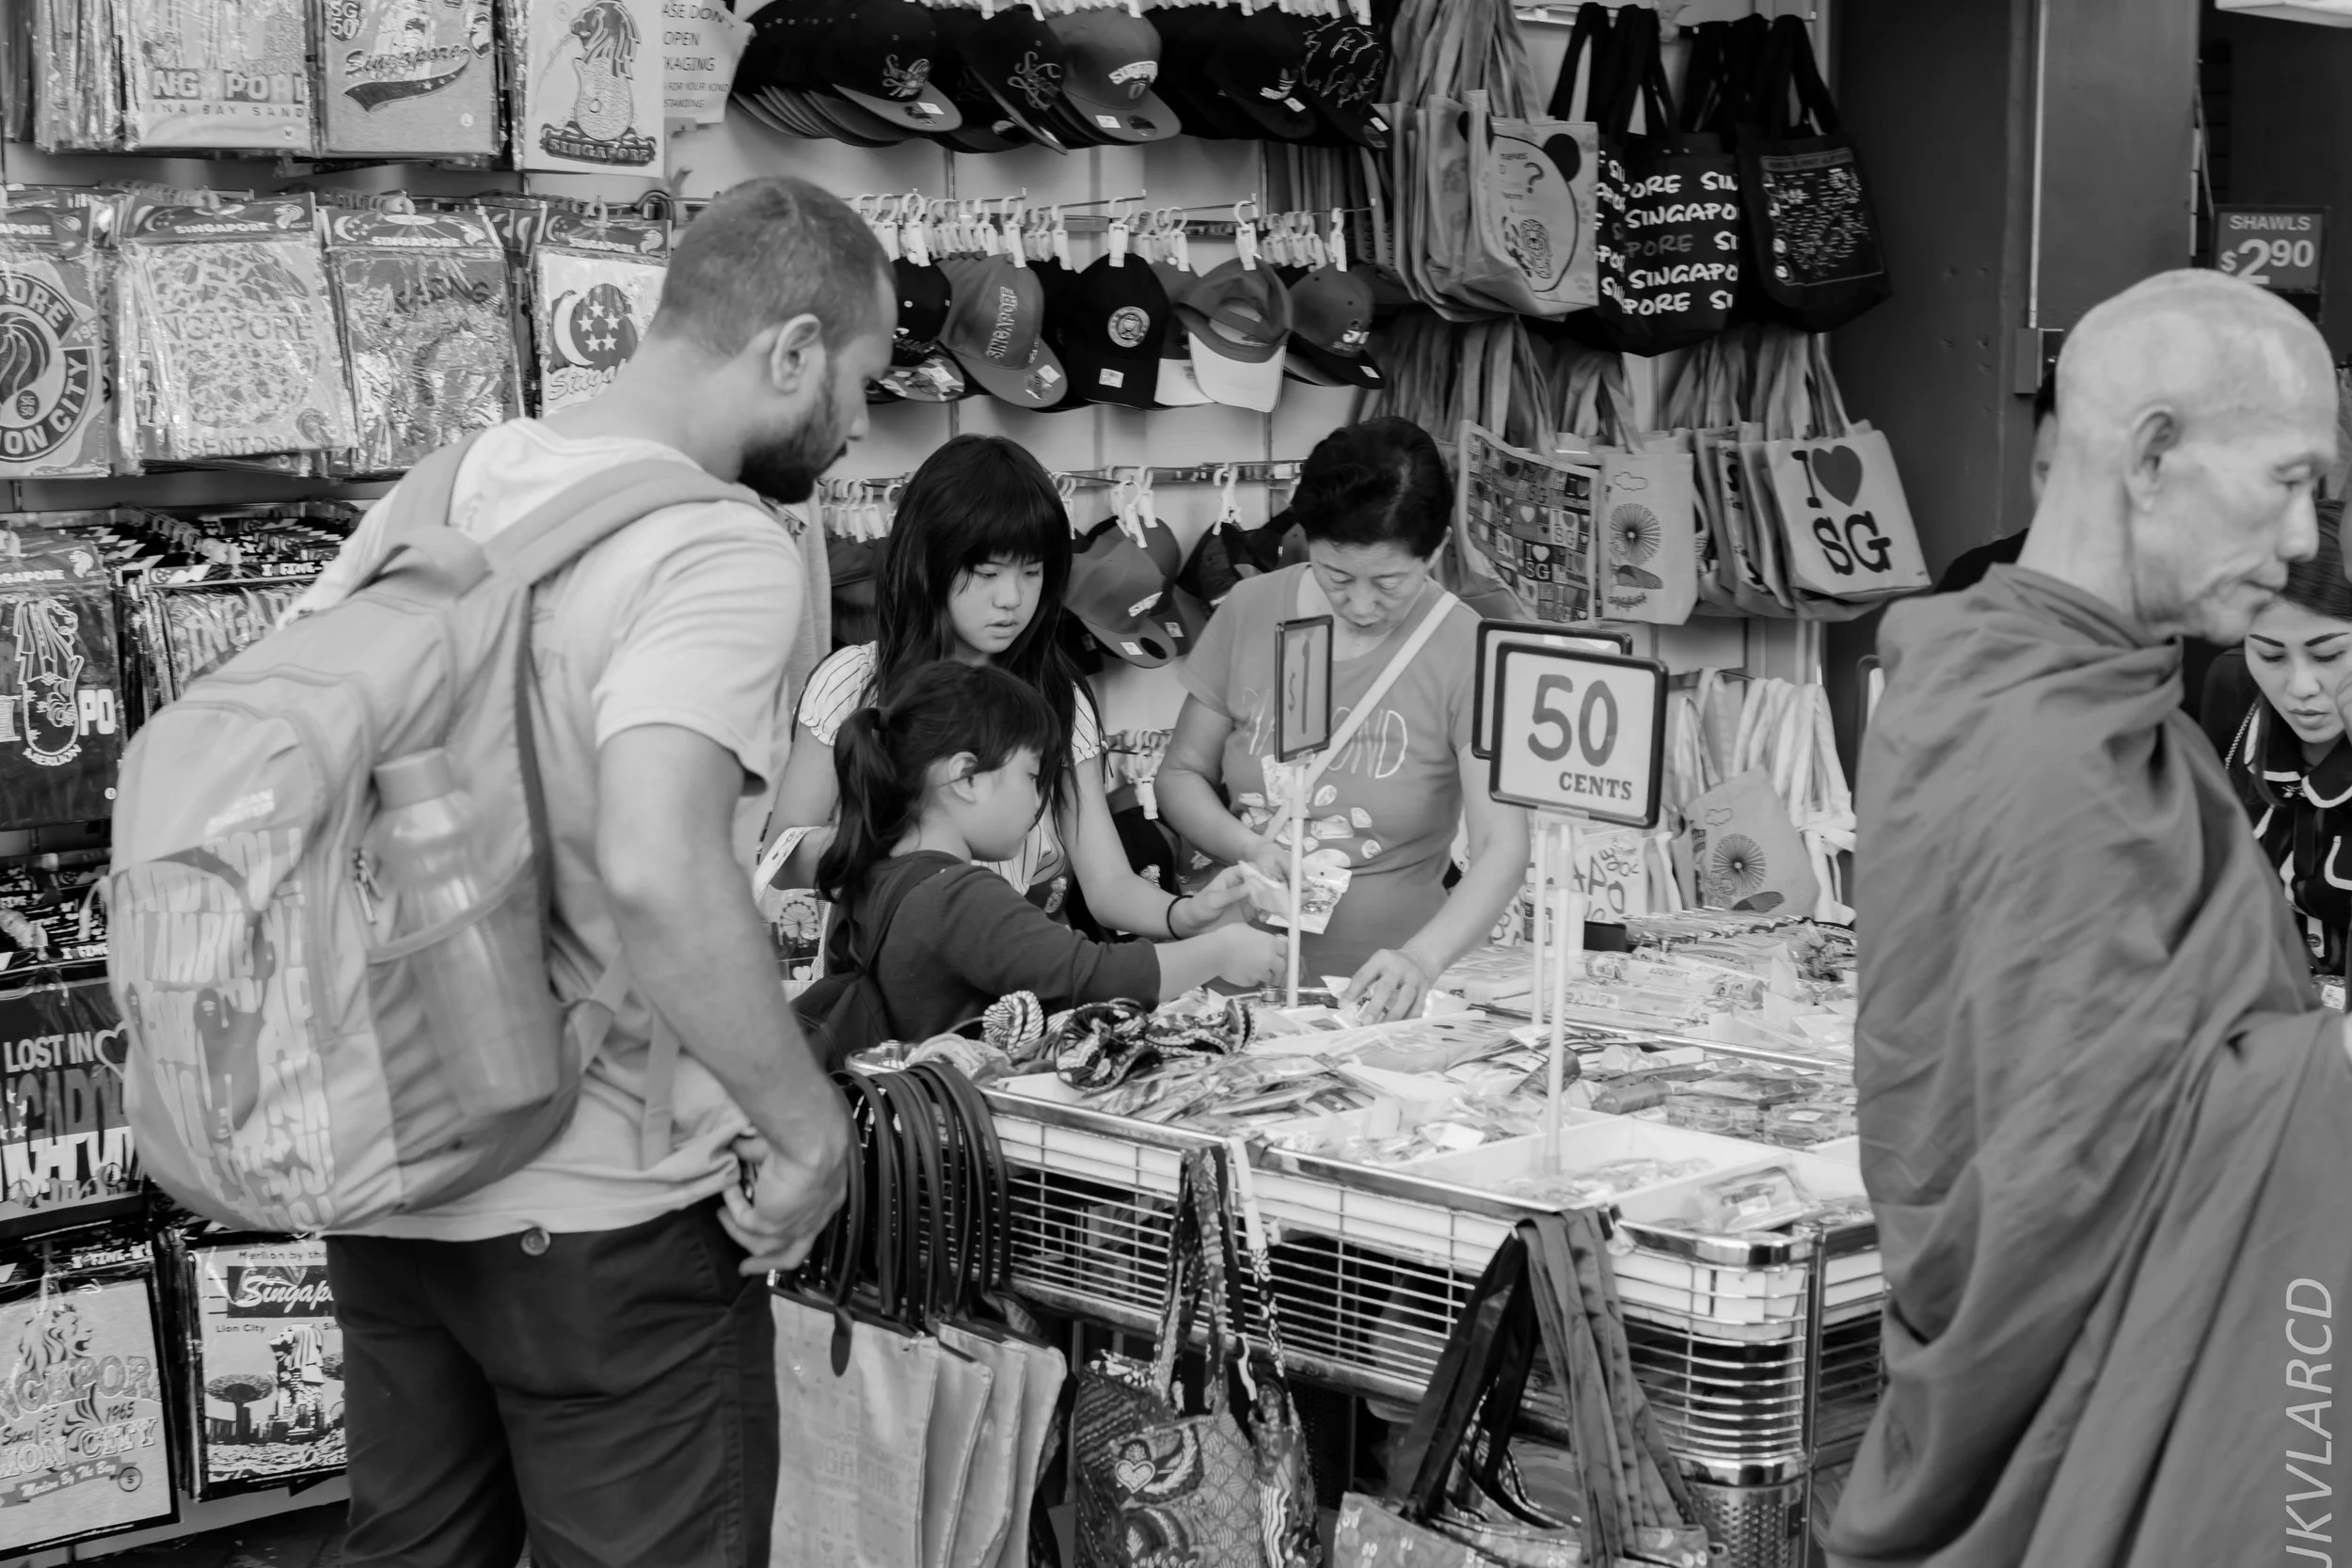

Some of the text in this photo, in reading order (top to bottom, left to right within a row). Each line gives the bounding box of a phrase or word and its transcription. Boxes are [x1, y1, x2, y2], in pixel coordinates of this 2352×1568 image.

[663, 31, 702, 46] OPEN
[662, 56, 716, 71] KAGING
[548, 138, 650, 162] SINGAPORE
[174, 222, 271, 234] SINGAPORE
[1625, 202, 1740, 229] SINGAPO
[2230, 214, 2312, 231] SHAWLS
[49, 356, 88, 434] CITY
[1791, 450, 1823, 509] I
[1812, 510, 1893, 577] SG
[1528, 673, 1618, 768] 50
[1559, 771, 1632, 800] CENTS
[3, 1031, 95, 1073] LOST IN
[215, 1324, 240, 1333] Lion
[243, 1323, 266, 1334] City
[105, 1401, 135, 1423] 1965
[81, 1415, 159, 1458] CITY
